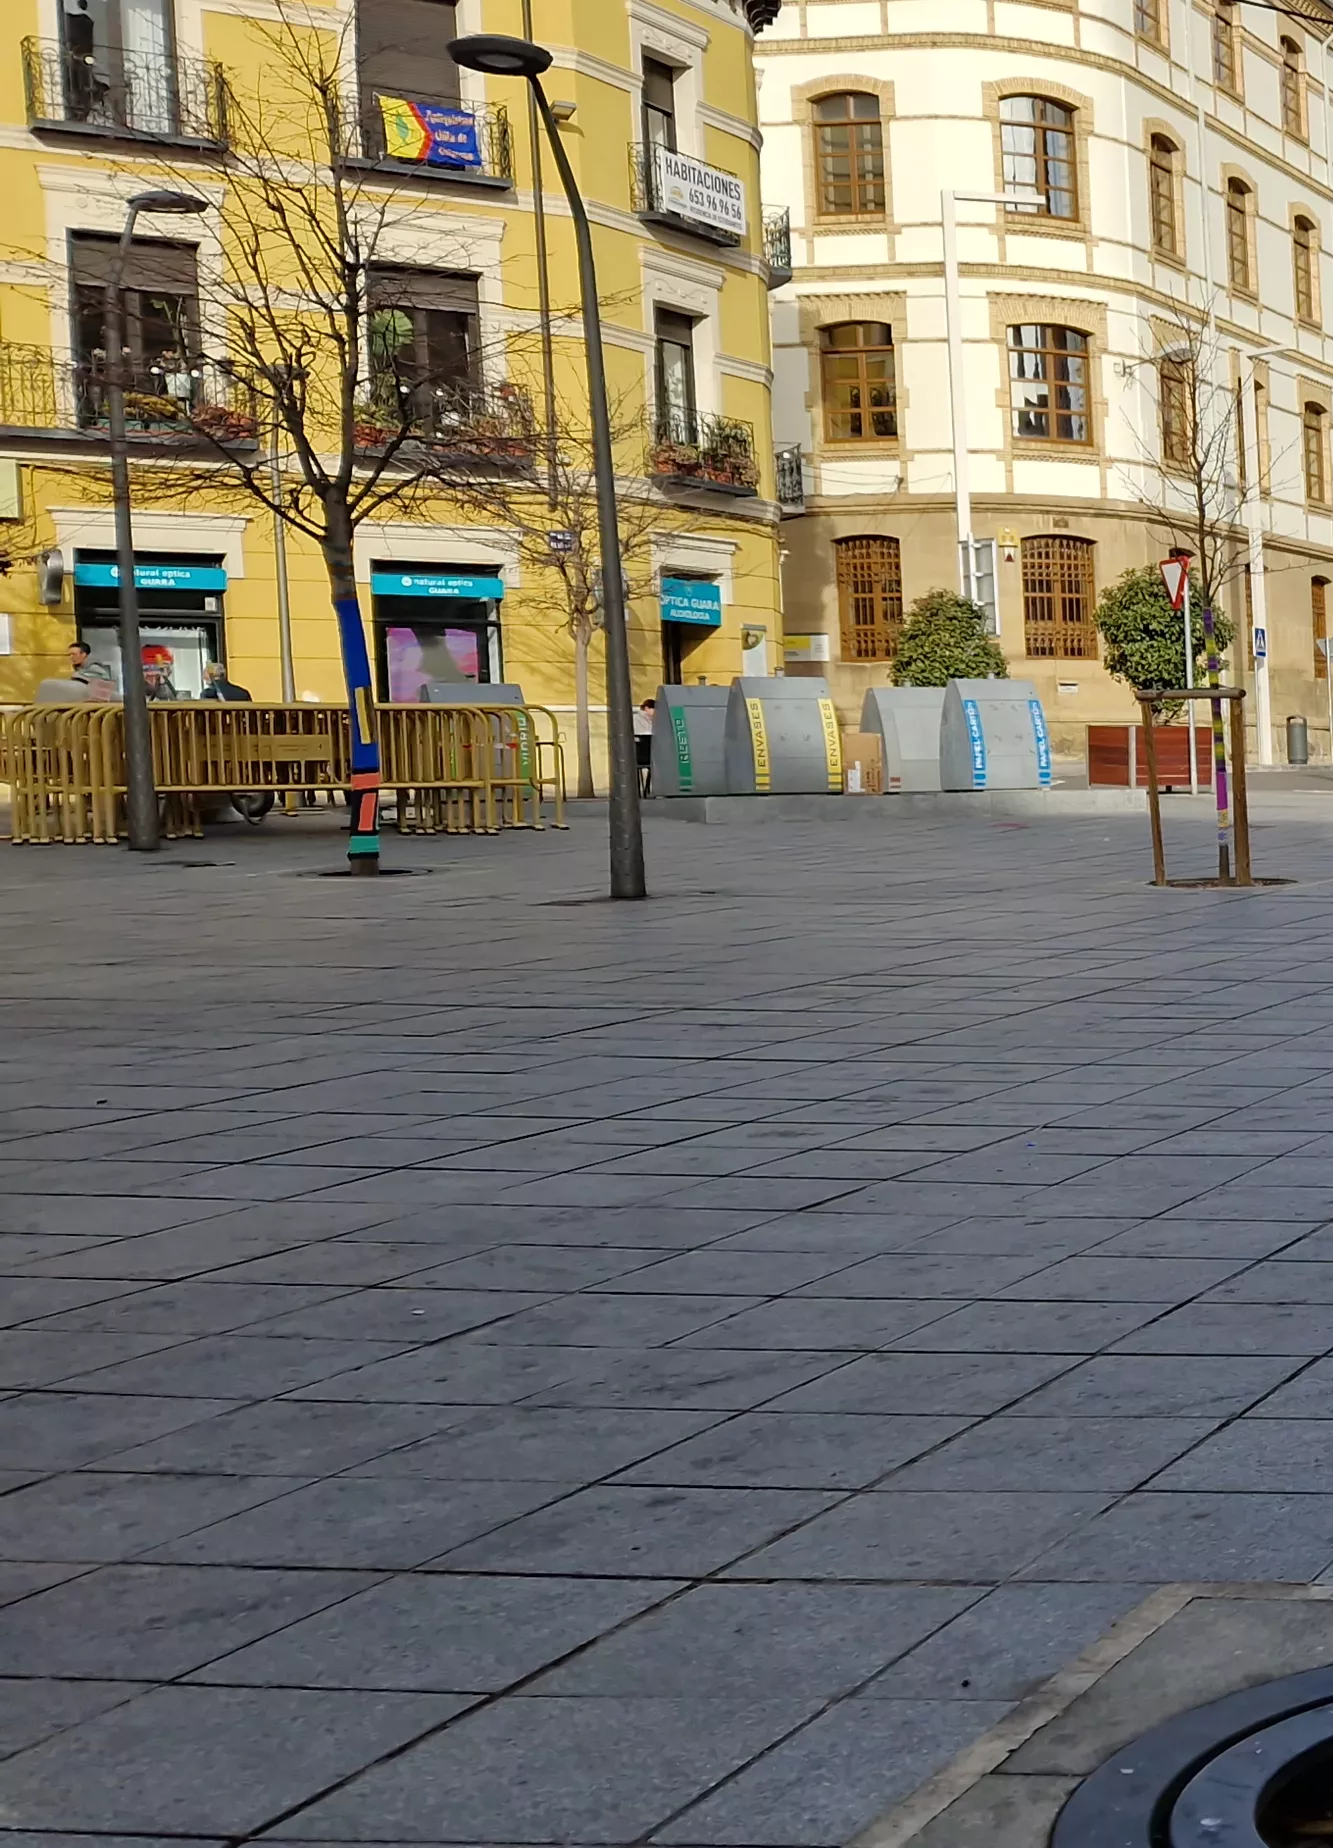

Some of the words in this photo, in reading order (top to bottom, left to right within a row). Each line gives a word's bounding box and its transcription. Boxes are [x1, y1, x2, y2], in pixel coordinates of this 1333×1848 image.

[665, 156, 741, 201] HABITACIONES
[689, 188, 704, 207] 653
[706, 194, 717, 211] 96
[719, 199, 729, 216] 96
[731, 203, 742, 220] 56
[140, 578, 176, 586] GUARA
[413, 578, 445, 587] natural
[691, 598, 720, 611] GUARA
[750, 703, 767, 767] ENVASES
[821, 703, 838, 767] ENVASES
